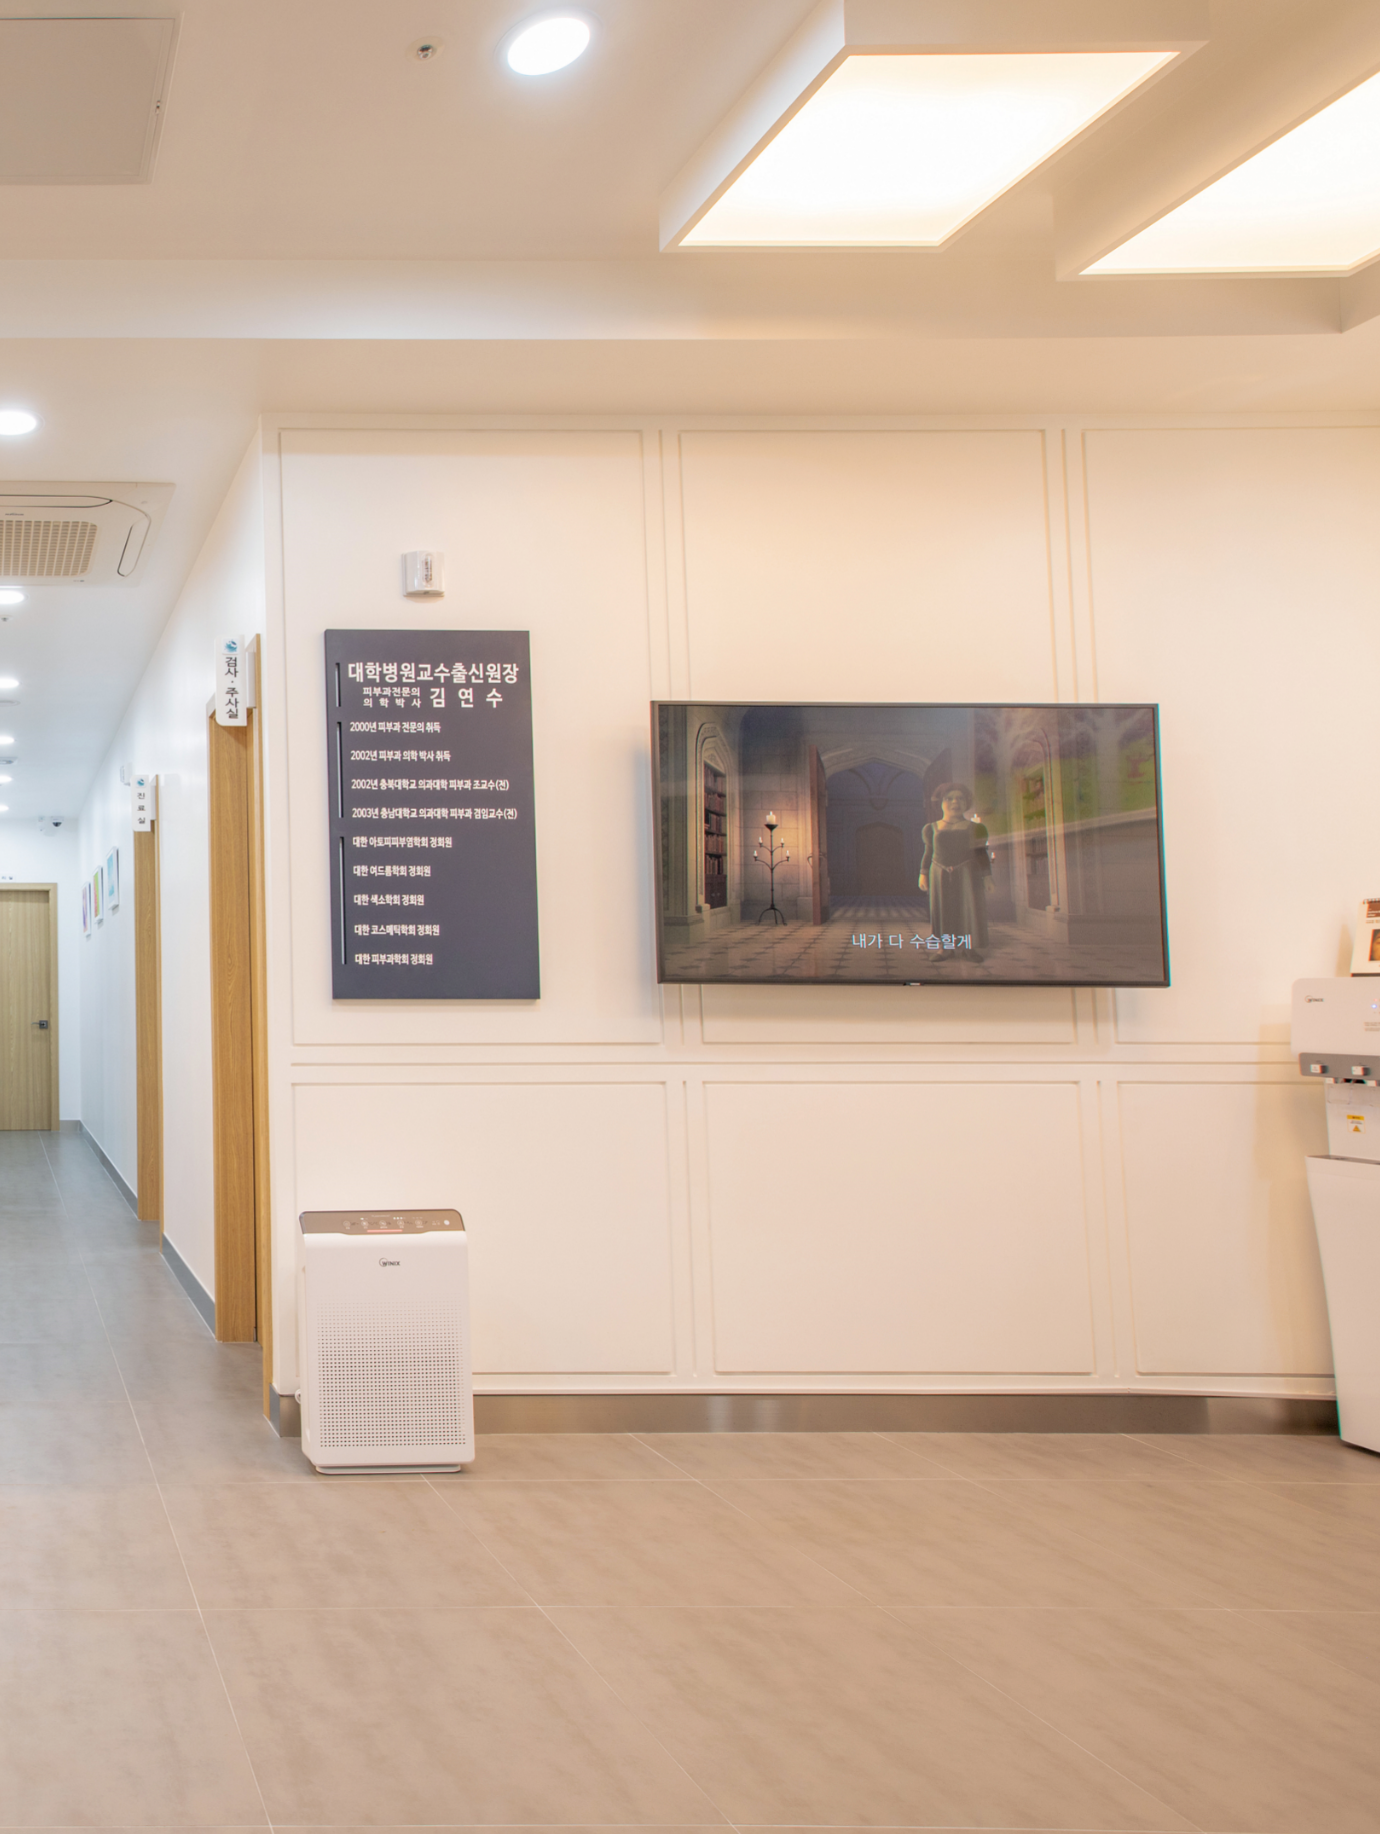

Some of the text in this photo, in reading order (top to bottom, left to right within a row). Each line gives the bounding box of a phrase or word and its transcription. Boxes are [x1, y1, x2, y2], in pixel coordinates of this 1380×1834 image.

[348, 662, 519, 684] 대학병원교수출신원장
[363, 687, 420, 697] 피부과전문의
[350, 722, 377, 733] 2000년
[378, 722, 401, 733] 피부과
[402, 722, 425, 733] 전문의
[351, 750, 377, 761] 2002년
[378, 750, 401, 761] 피부과
[402, 750, 418, 761] 의학
[419, 750, 435, 761] 박사
[351, 779, 378, 790] 2002년
[418, 779, 448, 790] 의과대학
[449, 779, 472, 790] 피부과
[352, 808, 379, 819] 2003년
[419, 808, 449, 819] 의과대학
[450, 808, 472, 819] 피부과
[352, 837, 453, 847] 대한 아토피피부염학회 정회원
[353, 865, 431, 877] 대한 여드름학회 정회원
[354, 894, 424, 906] 대한 색소학회 정회원
[354, 925, 440, 936] 대한 코스메틱학회 정회원
[852, 933, 972, 950] 내가 다 수습할게
[355, 954, 433, 965] 대한 피부과학회 정회원
